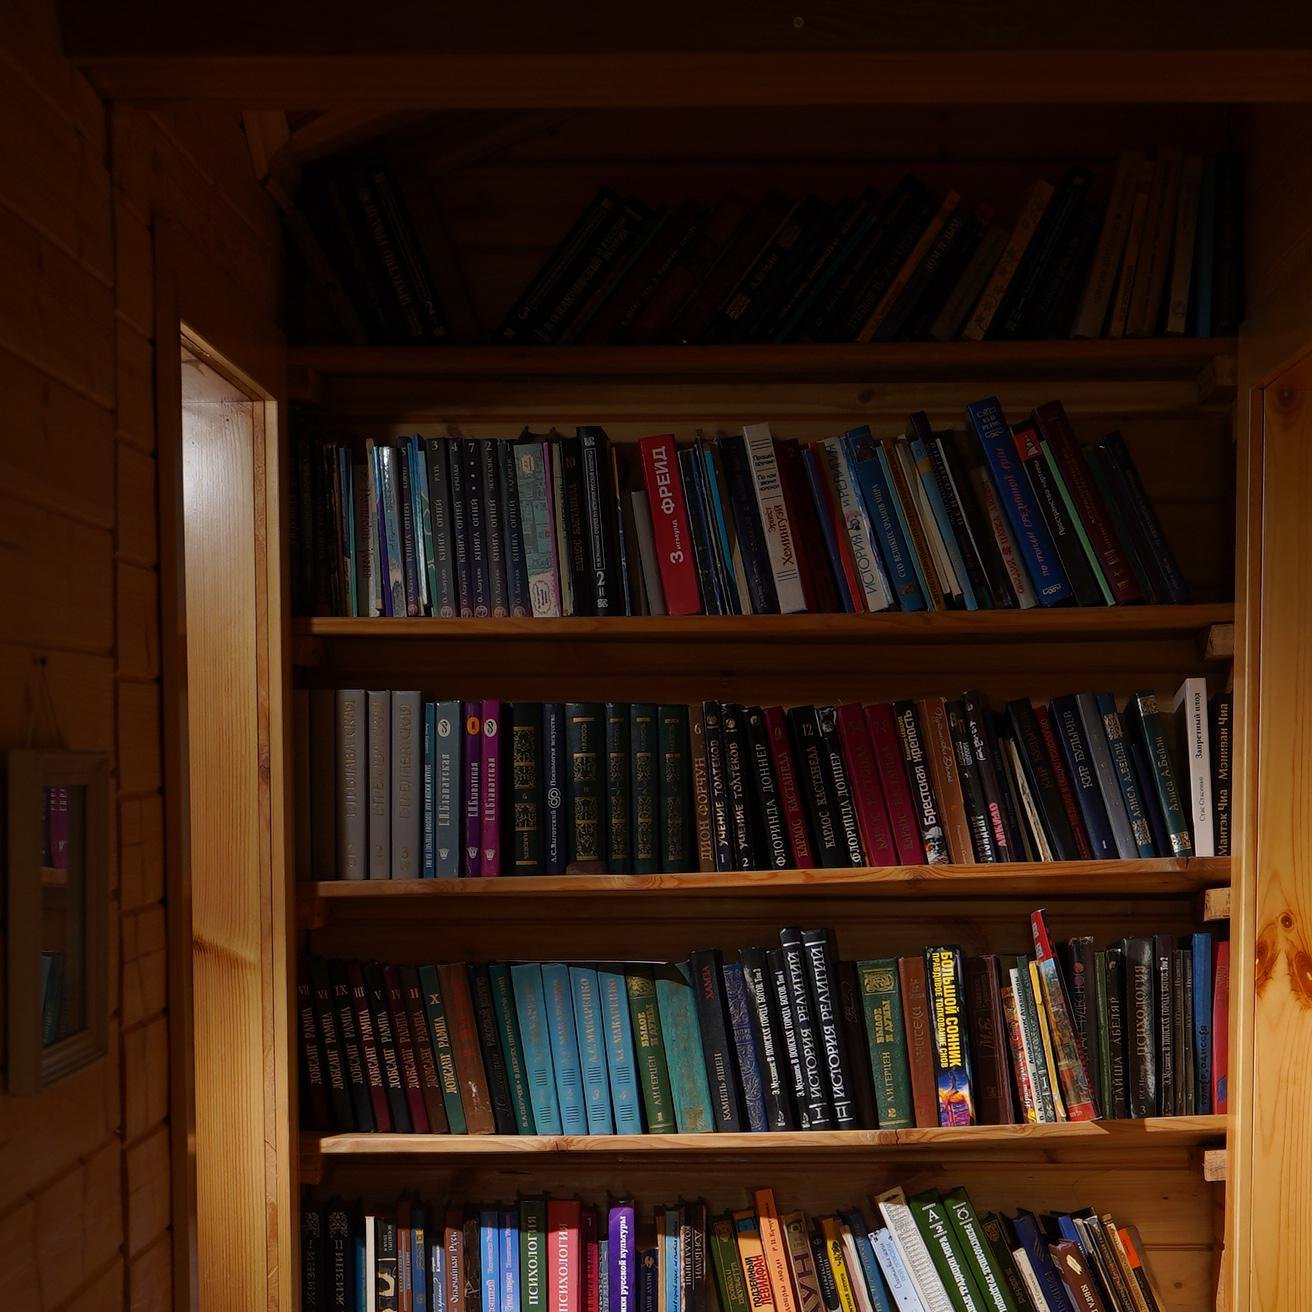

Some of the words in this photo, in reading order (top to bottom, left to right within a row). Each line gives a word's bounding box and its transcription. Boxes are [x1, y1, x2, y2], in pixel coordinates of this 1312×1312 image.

[652, 446, 675, 515] ФРЕЙД
[1033, 459, 1049, 487] картины
[455, 501, 463, 528] ОГНЕЙ
[471, 499, 479, 526] ОГНЕЙ
[1044, 488, 1066, 535] Пространство
[458, 535, 466, 562] КНИГА
[512, 533, 520, 561] КНИГА
[774, 505, 794, 565] Хемингуэй
[852, 534, 877, 594] ИСТОРИЯ
[896, 562, 906, 577] СТО
[1193, 692, 1201, 712] плод
[1215, 703, 1228, 725] Чиа
[903, 710, 923, 762] крепость
[1063, 710, 1085, 762] БУЛЫЧЕВ
[1194, 713, 1203, 759] Запретный
[1217, 727, 1228, 780] Мэниван
[695, 758, 708, 816] ФОРЧУН
[710, 740, 724, 796] ТОЛТЕКОВ
[729, 742, 743, 799] ТОЛТЕКОВ
[755, 744, 774, 793] ДОННЕР
[806, 744, 827, 806] КАСТАНЕДА
[829, 752, 848, 797] ДОННЕР
[1079, 765, 1093, 788] КИР
[914, 765, 937, 825] Брестская
[1217, 789, 1228, 811] Чиа
[698, 821, 712, 861] ДИОН
[715, 801, 728, 847] УЧЕНИЕ
[731, 804, 748, 850] УЧЕНИЕ
[765, 799, 786, 866] ФЛОРИНДА
[791, 818, 808, 858] КАРЛОС
[819, 811, 835, 849] КАРЛОС
[839, 800, 862, 863] ФЛОРИНДА
[990, 802, 1007, 847] АЙКИДО
[1217, 812, 1228, 856] Мантэк
[742, 858, 749, 867] 2
[787, 951, 809, 1022] РЕЛИГИЙ
[810, 946, 834, 1019] РЕЛИГИЙ
[932, 952, 944, 996] ПРАВДИВОЕ
[940, 951, 960, 1014] БОЛЬШОЙ
[301, 1007, 315, 1039] РАМПА
[322, 1012, 337, 1044] РАМПА
[340, 1006, 355, 1039] РАМПА
[359, 1009, 374, 1041] РАМПА
[376, 1011, 392, 1042] РАМПА
[395, 1011, 411, 1043] РАМПА
[414, 1010, 429, 1042] РАМПА
[637, 1011, 649, 1048] БЫЛОЕ
[873, 1007, 885, 1044] БЫЛОЕ
[936, 999, 948, 1046] ТОЛКОВАНИЕ
[1110, 996, 1121, 1046] АБЕЛЯР
[1134, 965, 1147, 1056] ПСИХОЛОГИЯ
[434, 1016, 449, 1048] РАМПА
[947, 1016, 962, 1067] СОННИК
[306, 1044, 322, 1085] ЛОБСАНГ
[328, 1049, 344, 1090] ЛОБСАНГ
[346, 1044, 363, 1085] ЛОБСАНГ
[365, 1046, 382, 1087] ЛОБСАНГ
[384, 1048, 401, 1089] ЛОБСАНГ
[403, 1047, 420, 1089] ЛОБСАНГ
[422, 1047, 439, 1088] ЛОБСАНГ
[440, 1053, 458, 1094] ЛОБСАНГ
[714, 1052, 726, 1081] ЯШЕН
[802, 1028, 822, 1099] ИСТОРИЯ
[825, 1025, 846, 1098] ИСТОРИЯ
[882, 1051, 895, 1087] ГЕРЦЕН
[941, 1048, 949, 1068] СНОВ
[1114, 1056, 1124, 1102] ТАЙША
[719, 1083, 732, 1121] КАМИЛЬ
[619, 1216, 628, 1258] культуры
[940, 1236, 955, 1257] МИРА
[335, 1250, 345, 1306] ЖИЗНИ
[527, 1215, 539, 1305] ПСИХОЛОГИЯ
[558, 1223, 569, 1312] ПСИХОЛОГИЯ
[619, 1260, 628, 1295] русской
[753, 1254, 772, 1306] ЛЕВИАФАН
[950, 1256, 970, 1296] ТРАДИЦИИ
[744, 1257, 762, 1308] ПОДЗЕМНЫЙ
[1080, 1284, 1097, 1307] КНИГА
